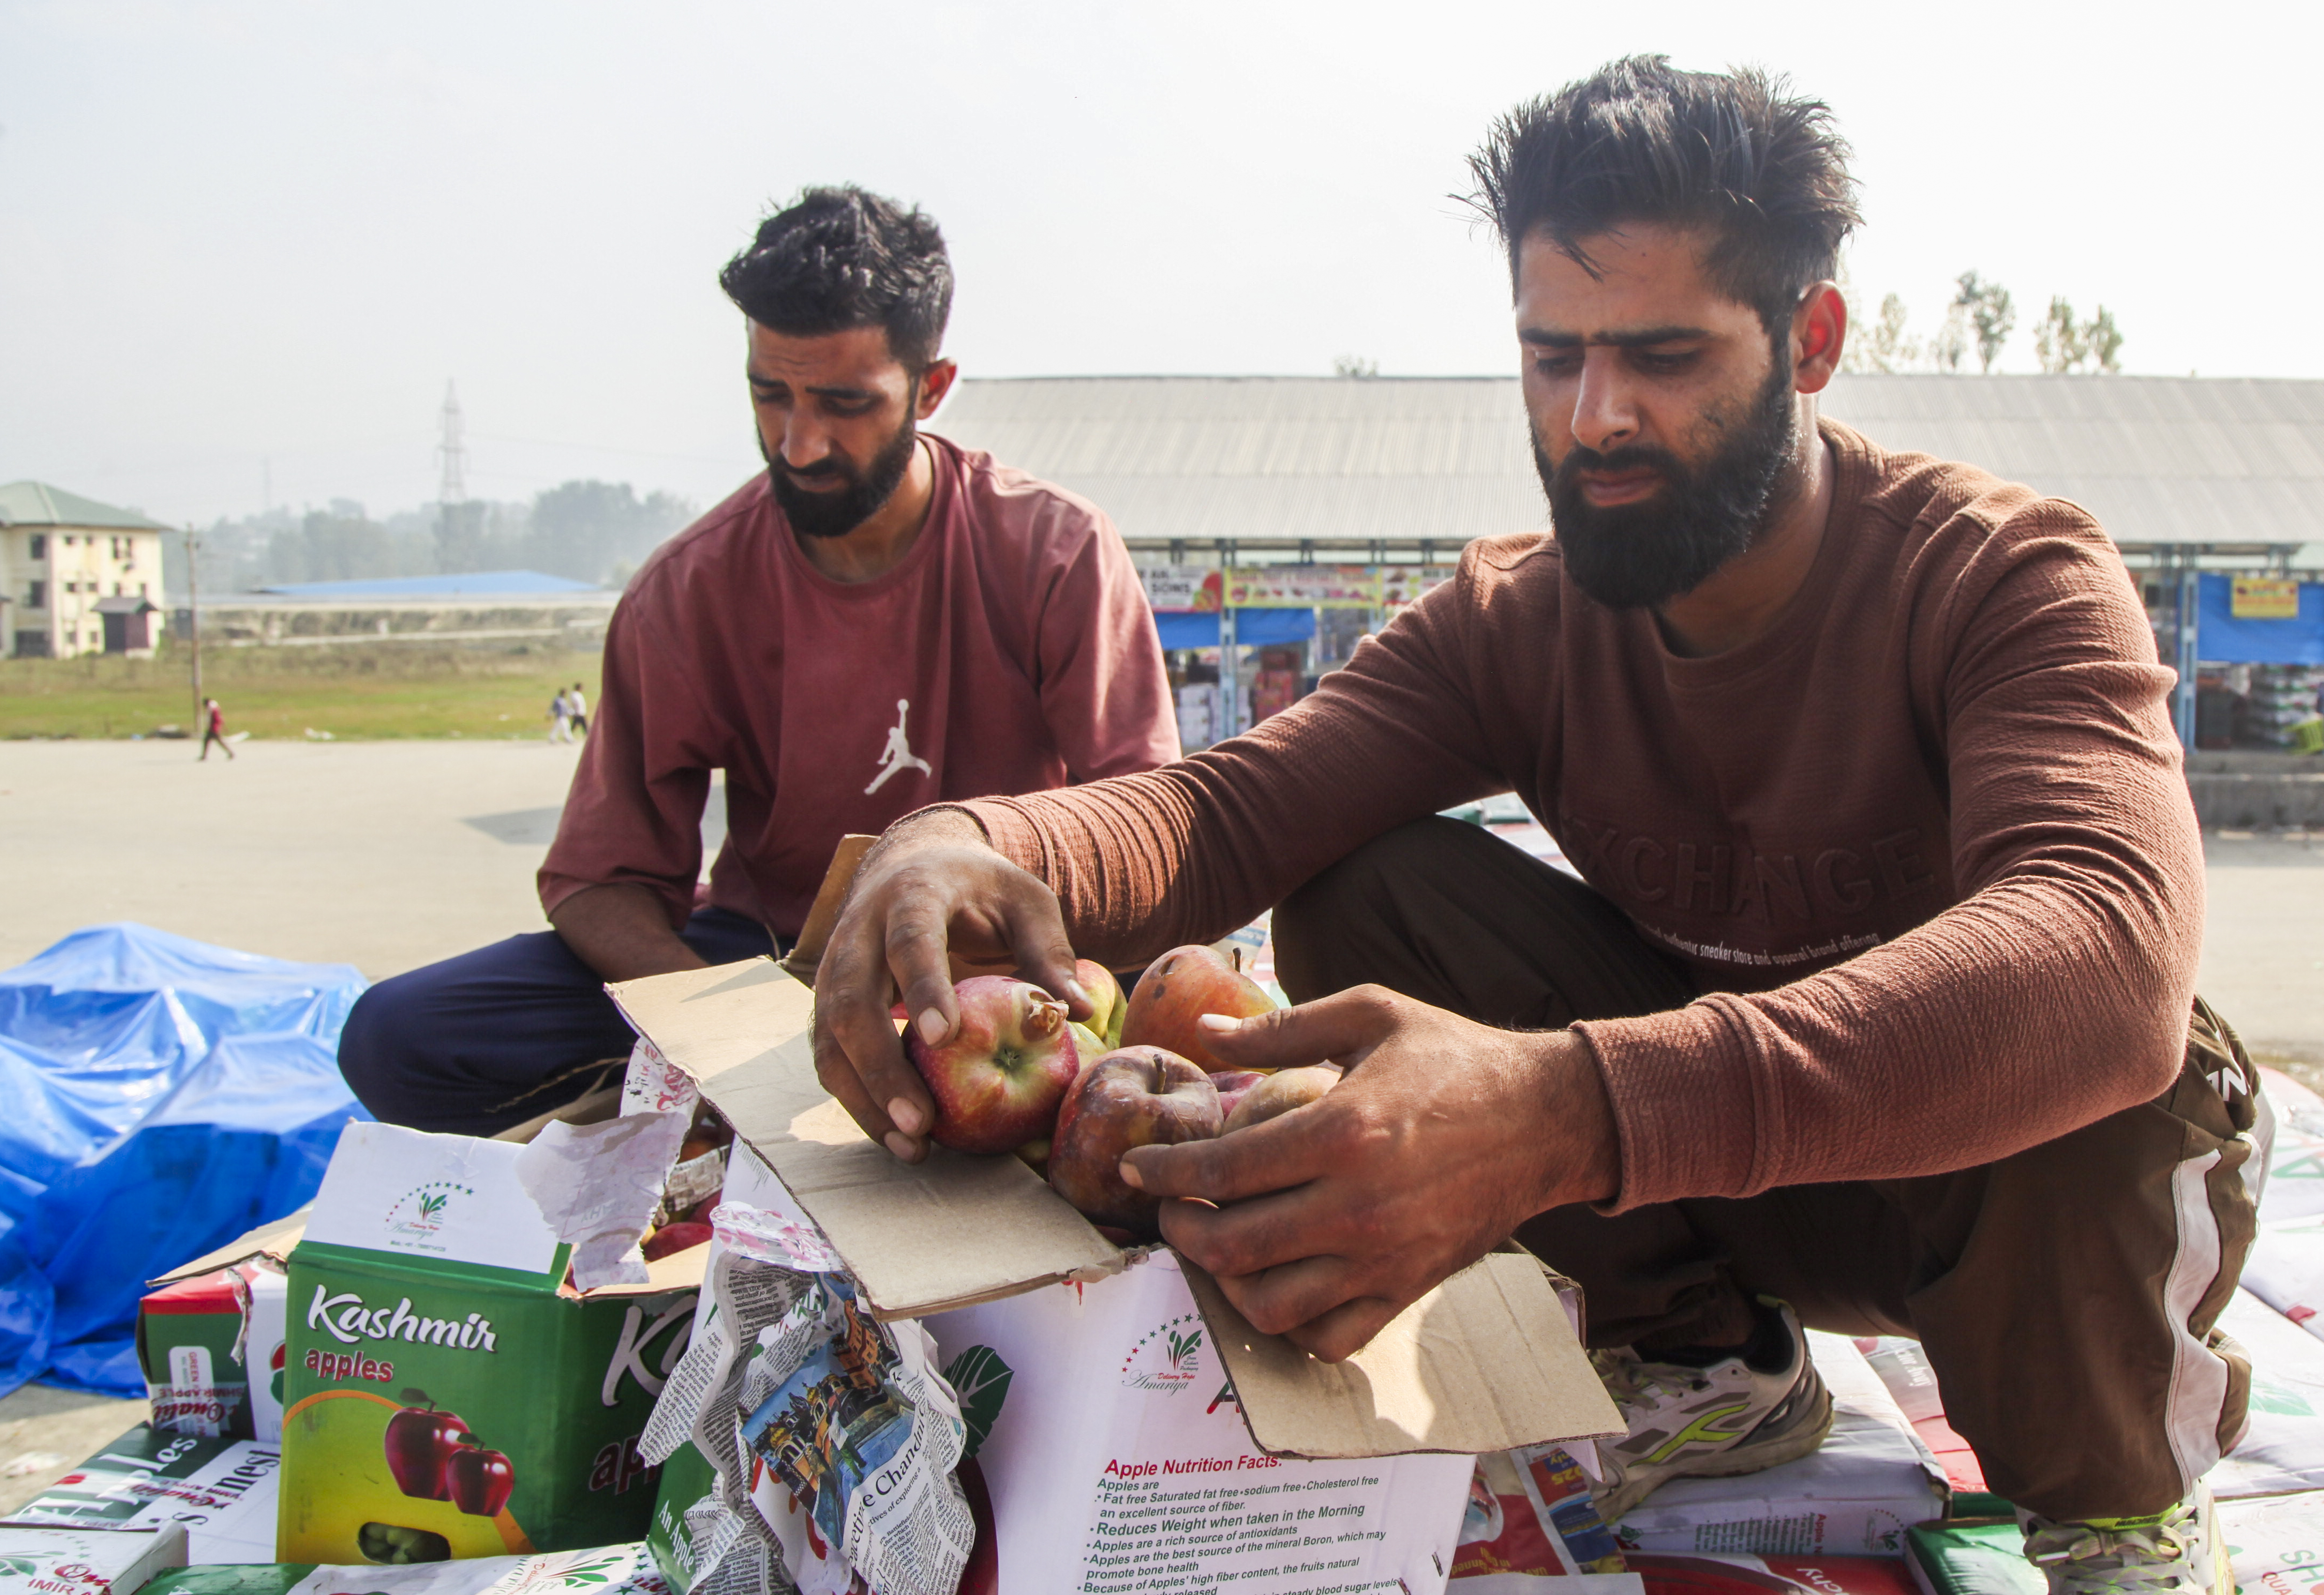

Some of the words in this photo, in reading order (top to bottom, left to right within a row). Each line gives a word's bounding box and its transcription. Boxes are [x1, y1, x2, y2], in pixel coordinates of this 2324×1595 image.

[1700, 941, 1732, 961] sneaker
[1733, 947, 1752, 965] store
[1754, 949, 1772, 966] and
[1772, 945, 1807, 966] apparel
[1806, 939, 1839, 959] brand
[307, 1283, 498, 1353] Kashmir
[305, 1348, 395, 1382] apples
[1158, 1372, 1180, 1380] Delivery
[1122, 1369, 1189, 1397] Amariya
[875, 1415, 925, 1496] Chandni
[1104, 1459, 1158, 1480] Apple
[1162, 1457, 1233, 1474] Nutrition
[1238, 1455, 1283, 1471] Facts.
[887, 1503, 895, 1512] of
[895, 1471, 919, 1504] exploring
[1097, 1478, 1139, 1492] Apples
[1143, 1482, 1159, 1490] are
[1103, 1493, 1123, 1504] Fat
[1127, 1494, 1147, 1504] free
[1150, 1488, 1201, 1503] Saturated
[1203, 1488, 1217, 1500] fat
[1219, 1488, 1238, 1498] free
[1244, 1485, 1280, 1496] sodium
[1283, 1483, 1301, 1493] free
[1307, 1477, 1360, 1491] Cholesterol
[1361, 1476, 1379, 1486] free
[1097, 1522, 1157, 1536] Reduces
[1162, 1518, 1207, 1533] Weight
[1210, 1516, 1243, 1529] when
[1246, 1512, 1279, 1526] taken
[1282, 1509, 1293, 1521] in
[1297, 1508, 1315, 1520] the
[1318, 1503, 1365, 1518] Morning
[1100, 1509, 1115, 1519] an
[1119, 1505, 1167, 1519] excellent
[1170, 1504, 1206, 1516] source
[1208, 1503, 1220, 1512] of
[1221, 1501, 1246, 1511] fiber.
[658, 1499, 673, 1533] An
[669, 1520, 694, 1573] Apple
[894, 1525, 910, 1538] which
[1093, 1539, 1133, 1553] Apples
[1136, 1539, 1153, 1549] are
[1156, 1538, 1162, 1547] a
[1165, 1535, 1185, 1546] rich
[1188, 1532, 1223, 1545] source
[1226, 1530, 1237, 1541] of
[1238, 1526, 1298, 1540] antioxidants
[1814, 1514, 1826, 1543] Apple
[902, 1552, 918, 1570] Delhi's
[1089, 1554, 1130, 1567] Apples
[1133, 1553, 1150, 1563] are
[1153, 1551, 1169, 1561] the
[1172, 1549, 1196, 1560] best
[1197, 1546, 1233, 1557] source
[1235, 1542, 1246, 1553] of
[1247, 1541, 1263, 1552] the
[1265, 1537, 1301, 1550] mineral
[1303, 1535, 1334, 1547] Boron,
[1337, 1531, 1364, 1543] which
[1366, 1530, 1387, 1541] may
[1084, 1582, 1133, 1594] Because
[1136, 1580, 1147, 1590] of
[1148, 1576, 1189, 1590] Apples'
[1191, 1573, 1213, 1586] high
[1216, 1571, 1239, 1582] fiber
[1241, 1566, 1280, 1580] content,
[1283, 1564, 1299, 1575] the
[1300, 1560, 1325, 1572] fruits
[1327, 1556, 1361, 1569] natural
[1086, 1568, 1134, 1580] promote
[1137, 1565, 1164, 1577] bone
[1167, 1561, 1199, 1573] health
[1316, 1583, 1343, 1595] blood
[1345, 1582, 1372, 1595] sugar
[1373, 1578, 1398, 1590] levels
